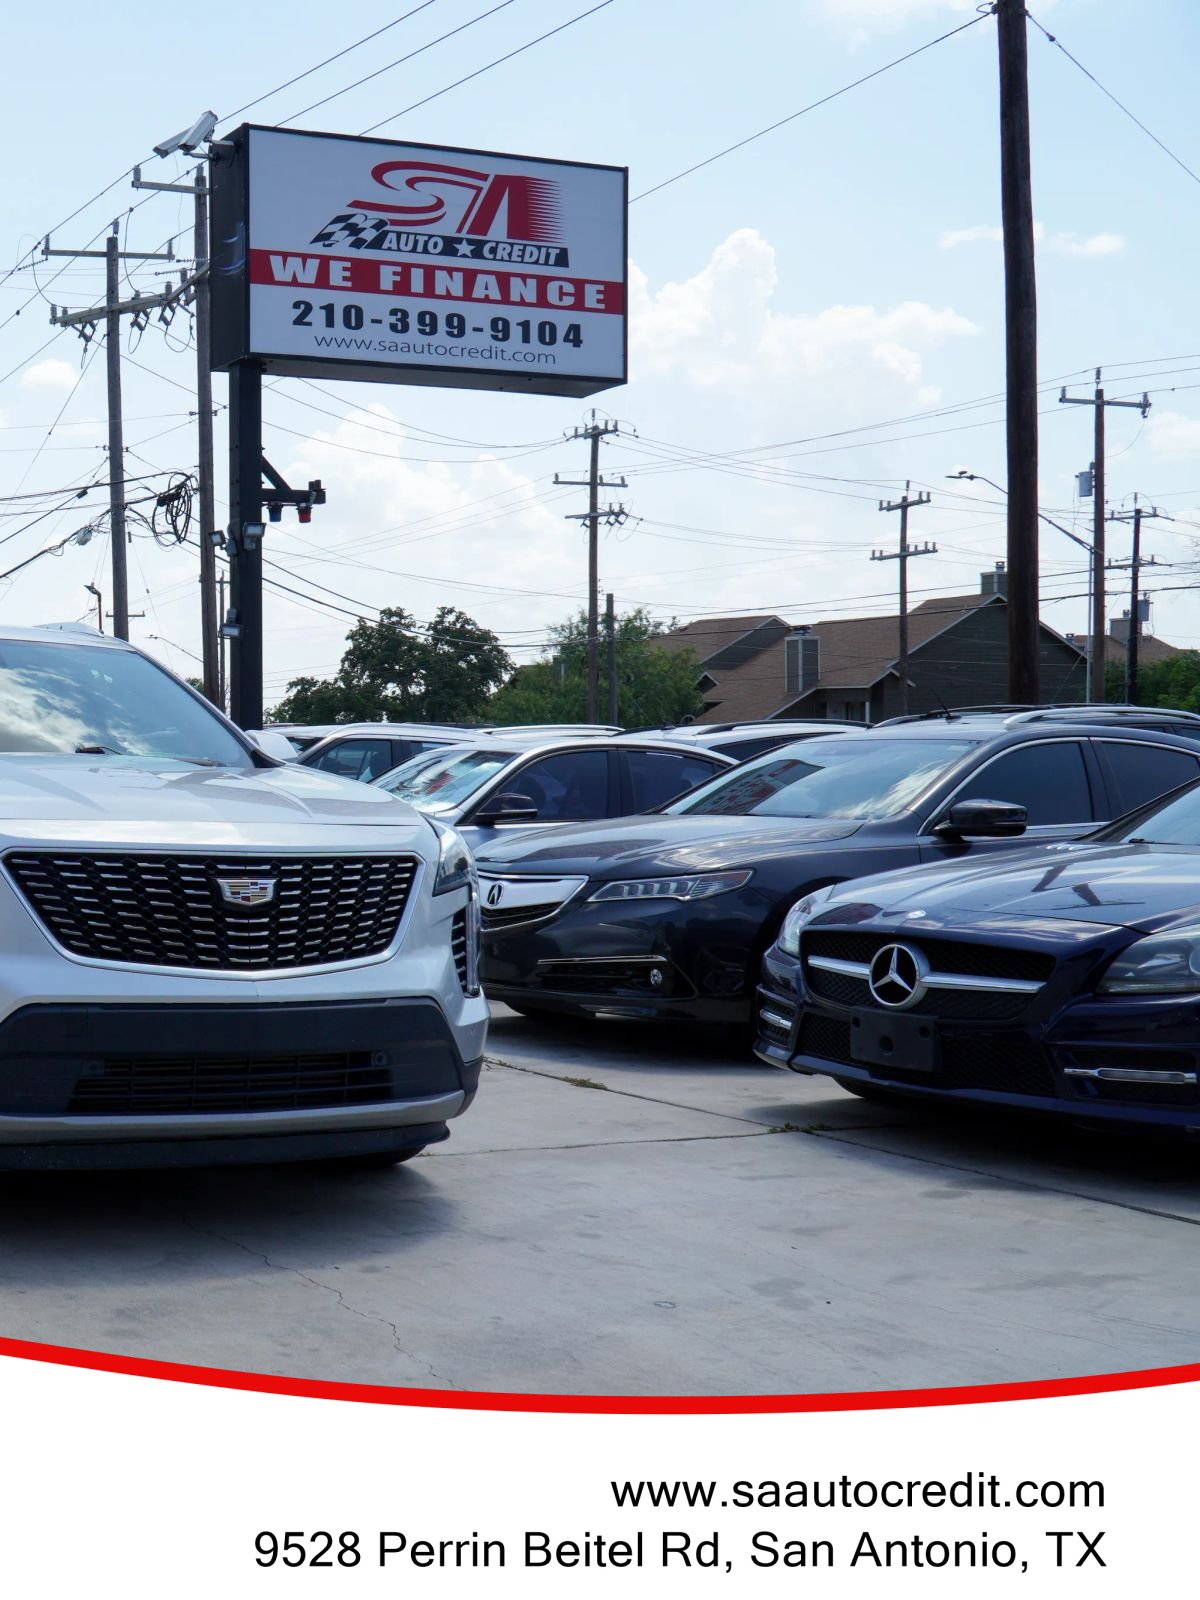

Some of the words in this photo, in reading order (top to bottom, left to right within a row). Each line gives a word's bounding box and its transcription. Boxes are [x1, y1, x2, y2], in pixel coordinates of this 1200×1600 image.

[346, 160, 566, 244] SA
[381, 231, 444, 255] AUTO
[482, 241, 560, 266] CREDIT
[269, 255, 352, 288] WE
[379, 264, 606, 310] FINANCE
[292, 300, 584, 349] 210-399-9104
[314, 335, 557, 365] www.saautocredit.com
